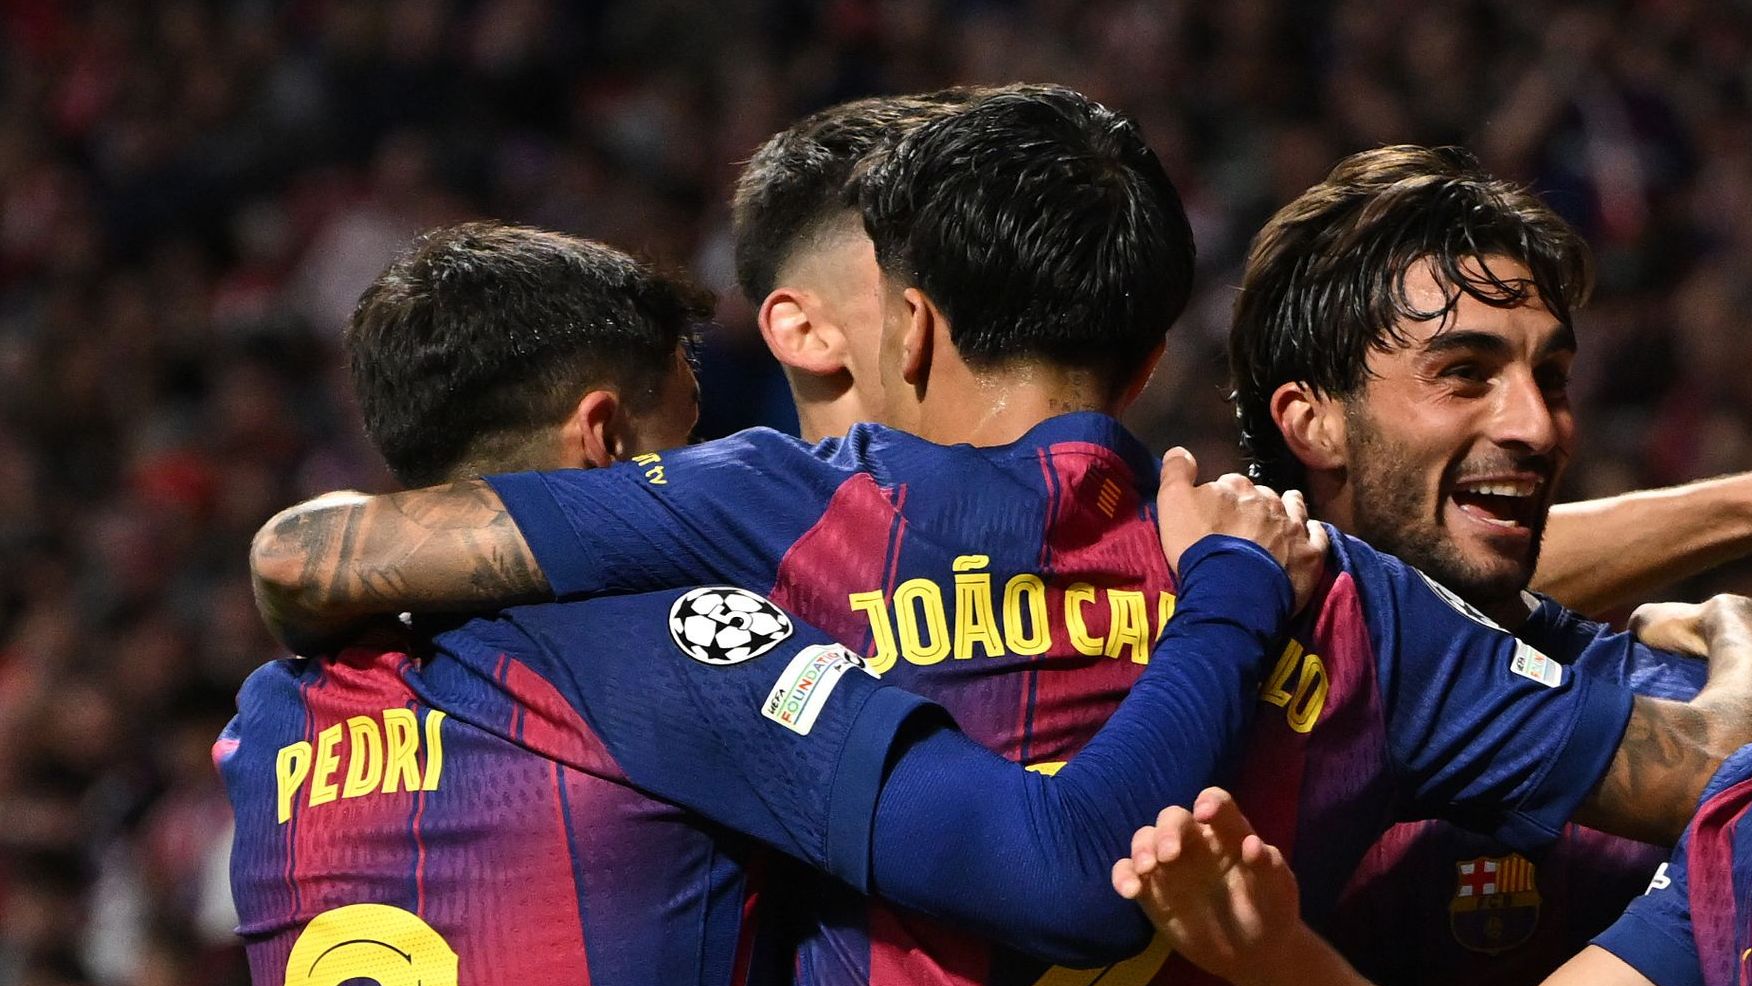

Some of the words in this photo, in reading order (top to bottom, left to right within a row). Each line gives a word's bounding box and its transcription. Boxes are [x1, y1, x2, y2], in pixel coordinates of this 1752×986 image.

[781, 651, 839, 723] FOUNDATIO
[849, 555, 1052, 676] JOÃO
[1065, 582, 1329, 733] CALO
[767, 688, 787, 715] UEFA
[276, 708, 447, 824] PEDRI
